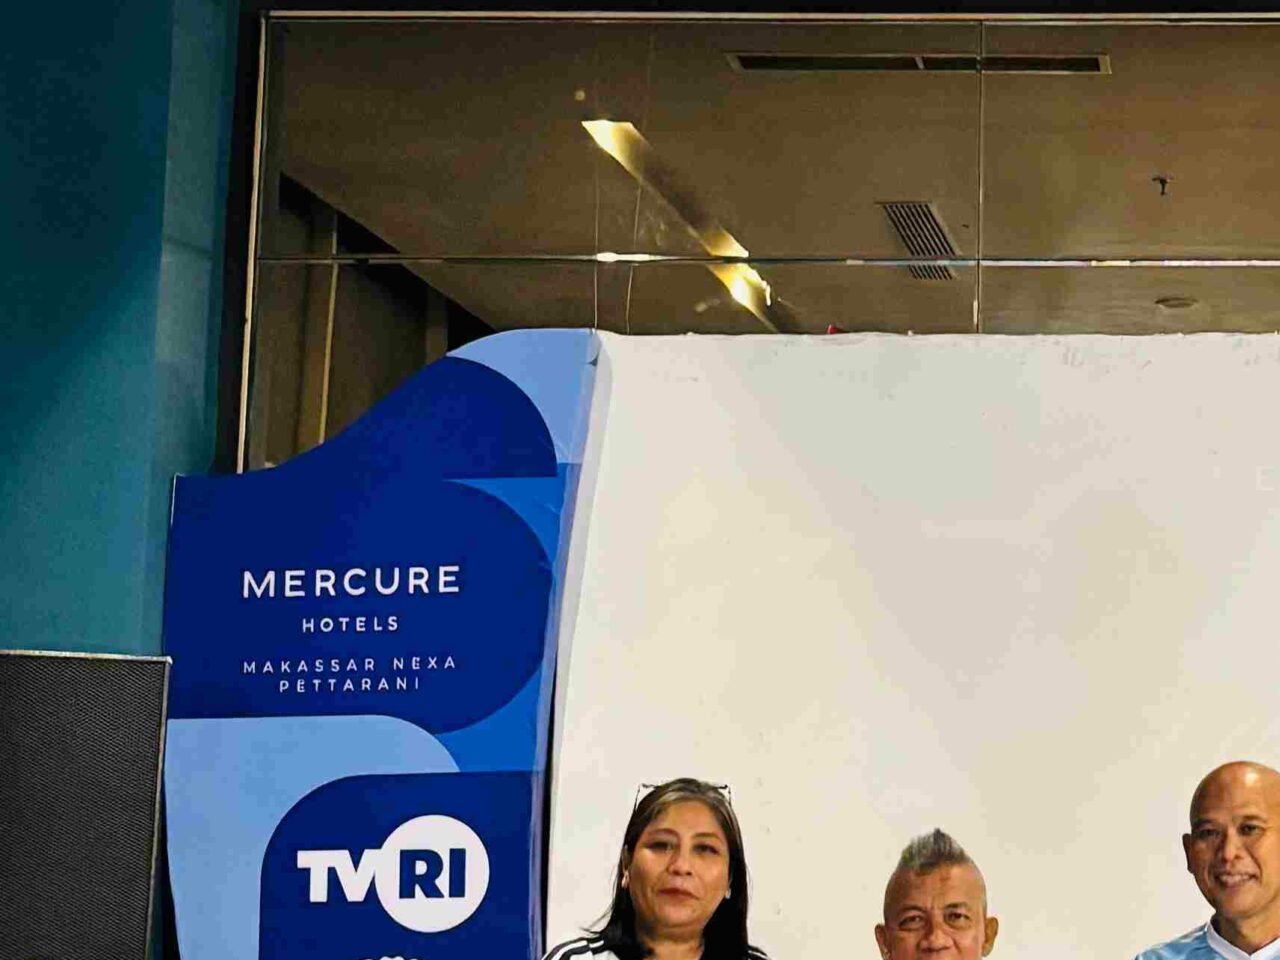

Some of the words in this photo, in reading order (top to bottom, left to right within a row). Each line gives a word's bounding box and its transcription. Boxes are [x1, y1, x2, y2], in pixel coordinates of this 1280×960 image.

[243, 565, 460, 598] MERCURE
[302, 615, 399, 633] HOTELS
[243, 658, 376, 674] MAKASSAR
[393, 655, 456, 670] NEXA
[279, 676, 420, 693] PETTARANI
